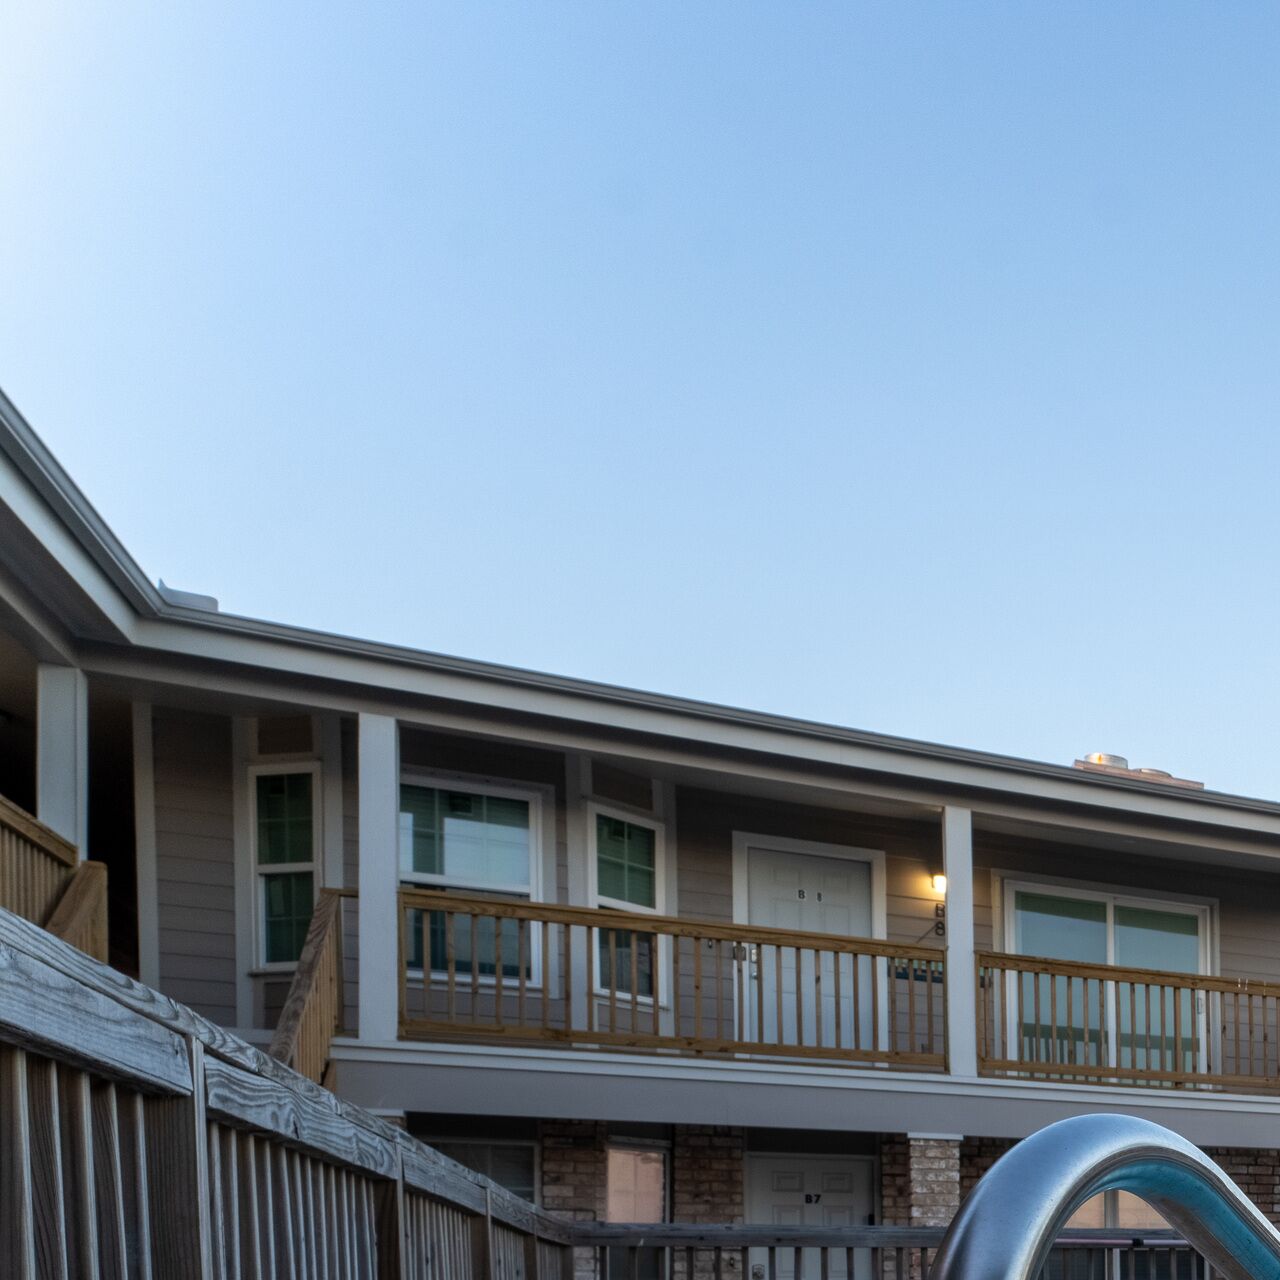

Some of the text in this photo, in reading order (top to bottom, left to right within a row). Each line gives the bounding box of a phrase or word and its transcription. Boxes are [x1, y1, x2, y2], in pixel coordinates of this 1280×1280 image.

[798, 889, 806, 899] B
[935, 921, 945, 936] 8
[805, 1193, 821, 1204] B7
